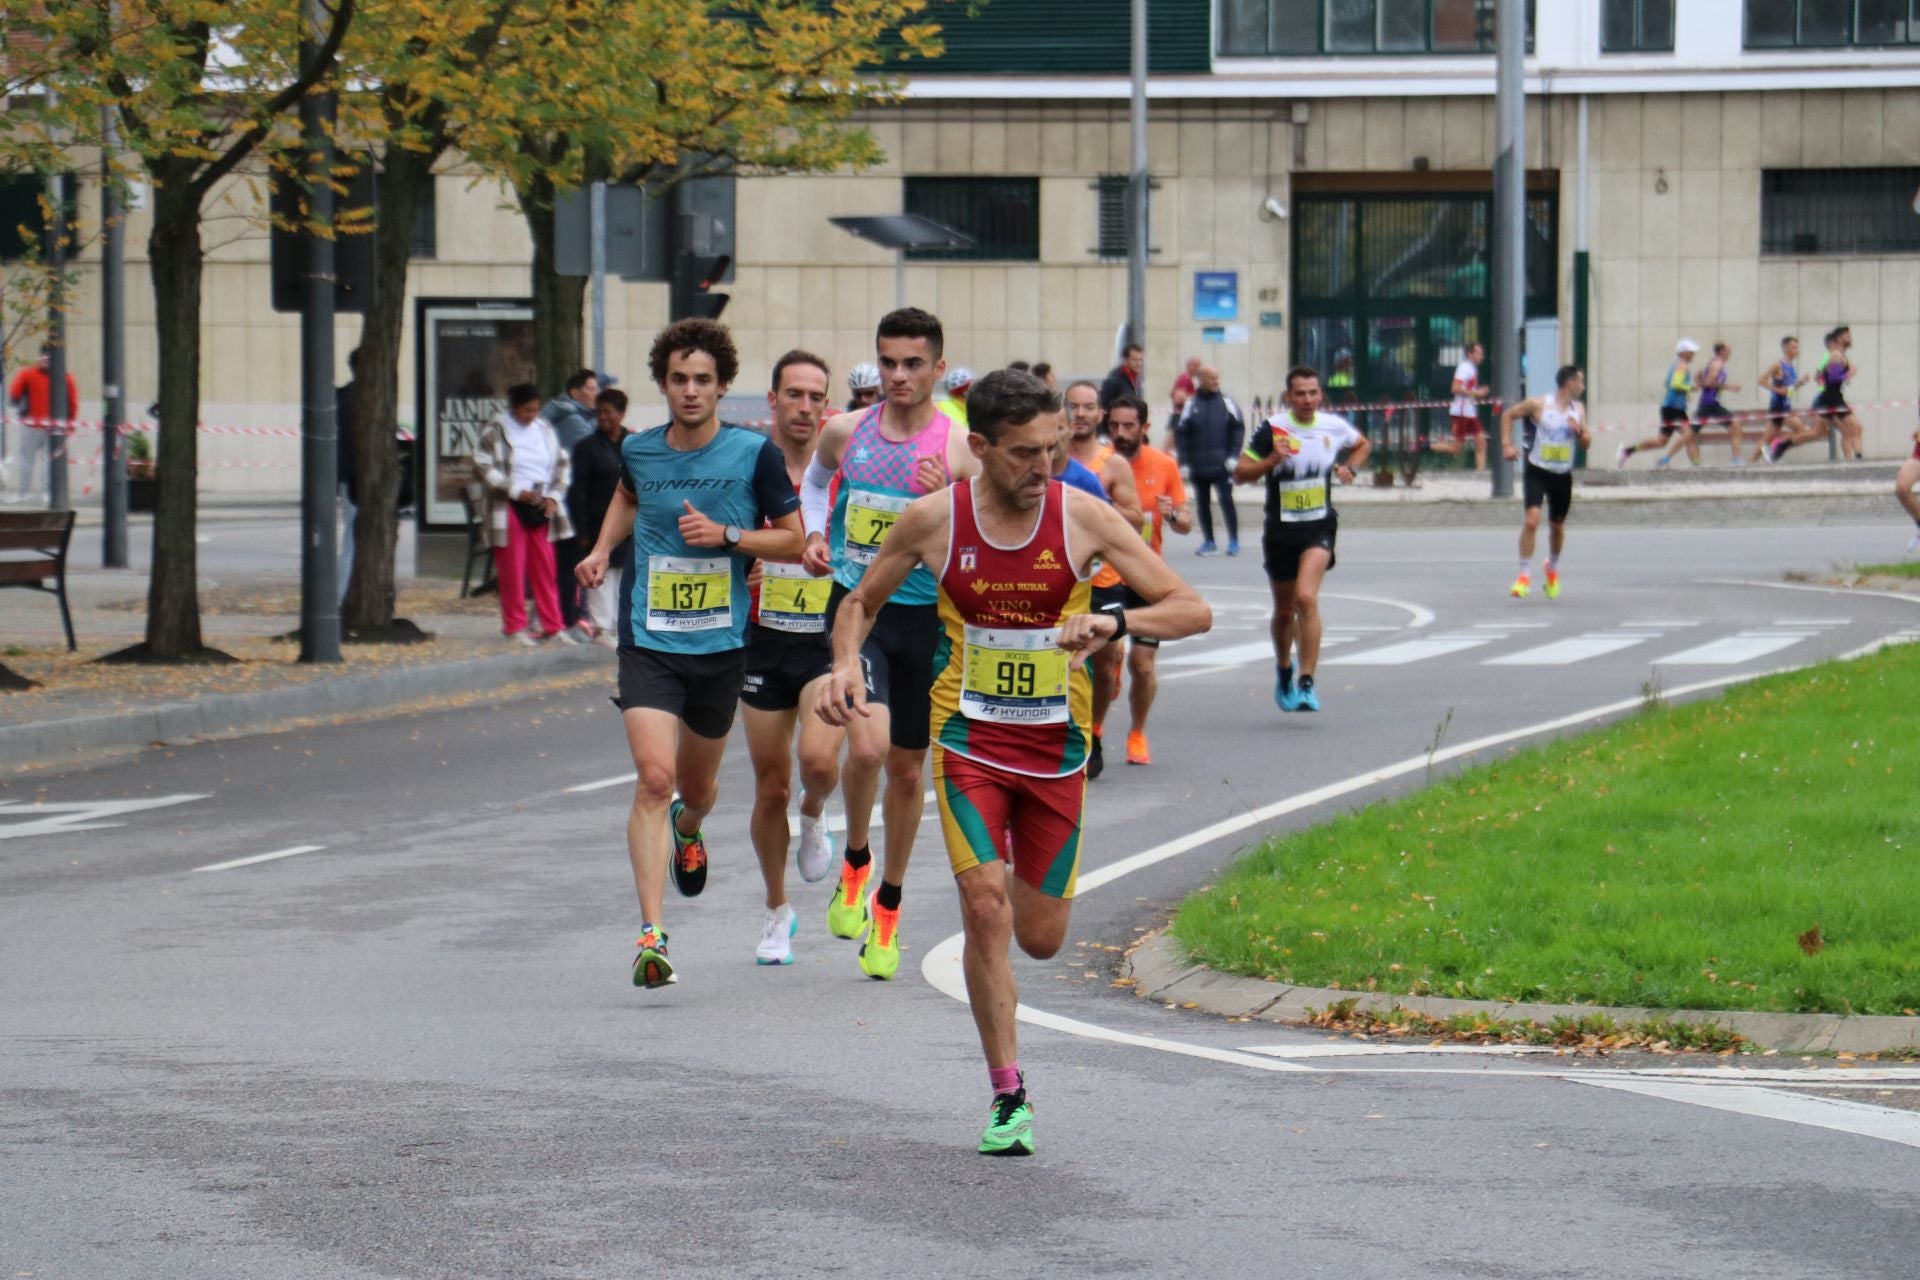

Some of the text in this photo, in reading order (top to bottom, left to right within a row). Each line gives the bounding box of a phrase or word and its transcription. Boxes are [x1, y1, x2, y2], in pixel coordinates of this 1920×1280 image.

[642, 478, 735, 492] DYNAFIT
[1295, 494, 1311, 510] 94
[991, 583, 1049, 591] CAJA RURAL
[671, 582, 708, 609] 137
[793, 588, 807, 612] 4
[988, 600, 1032, 611] VINO
[679, 616, 717, 626] HYUNDAI
[1000, 611, 1045, 624] TORO
[996, 661, 1035, 697] 99
[1000, 708, 1051, 718] HYUNDAI
